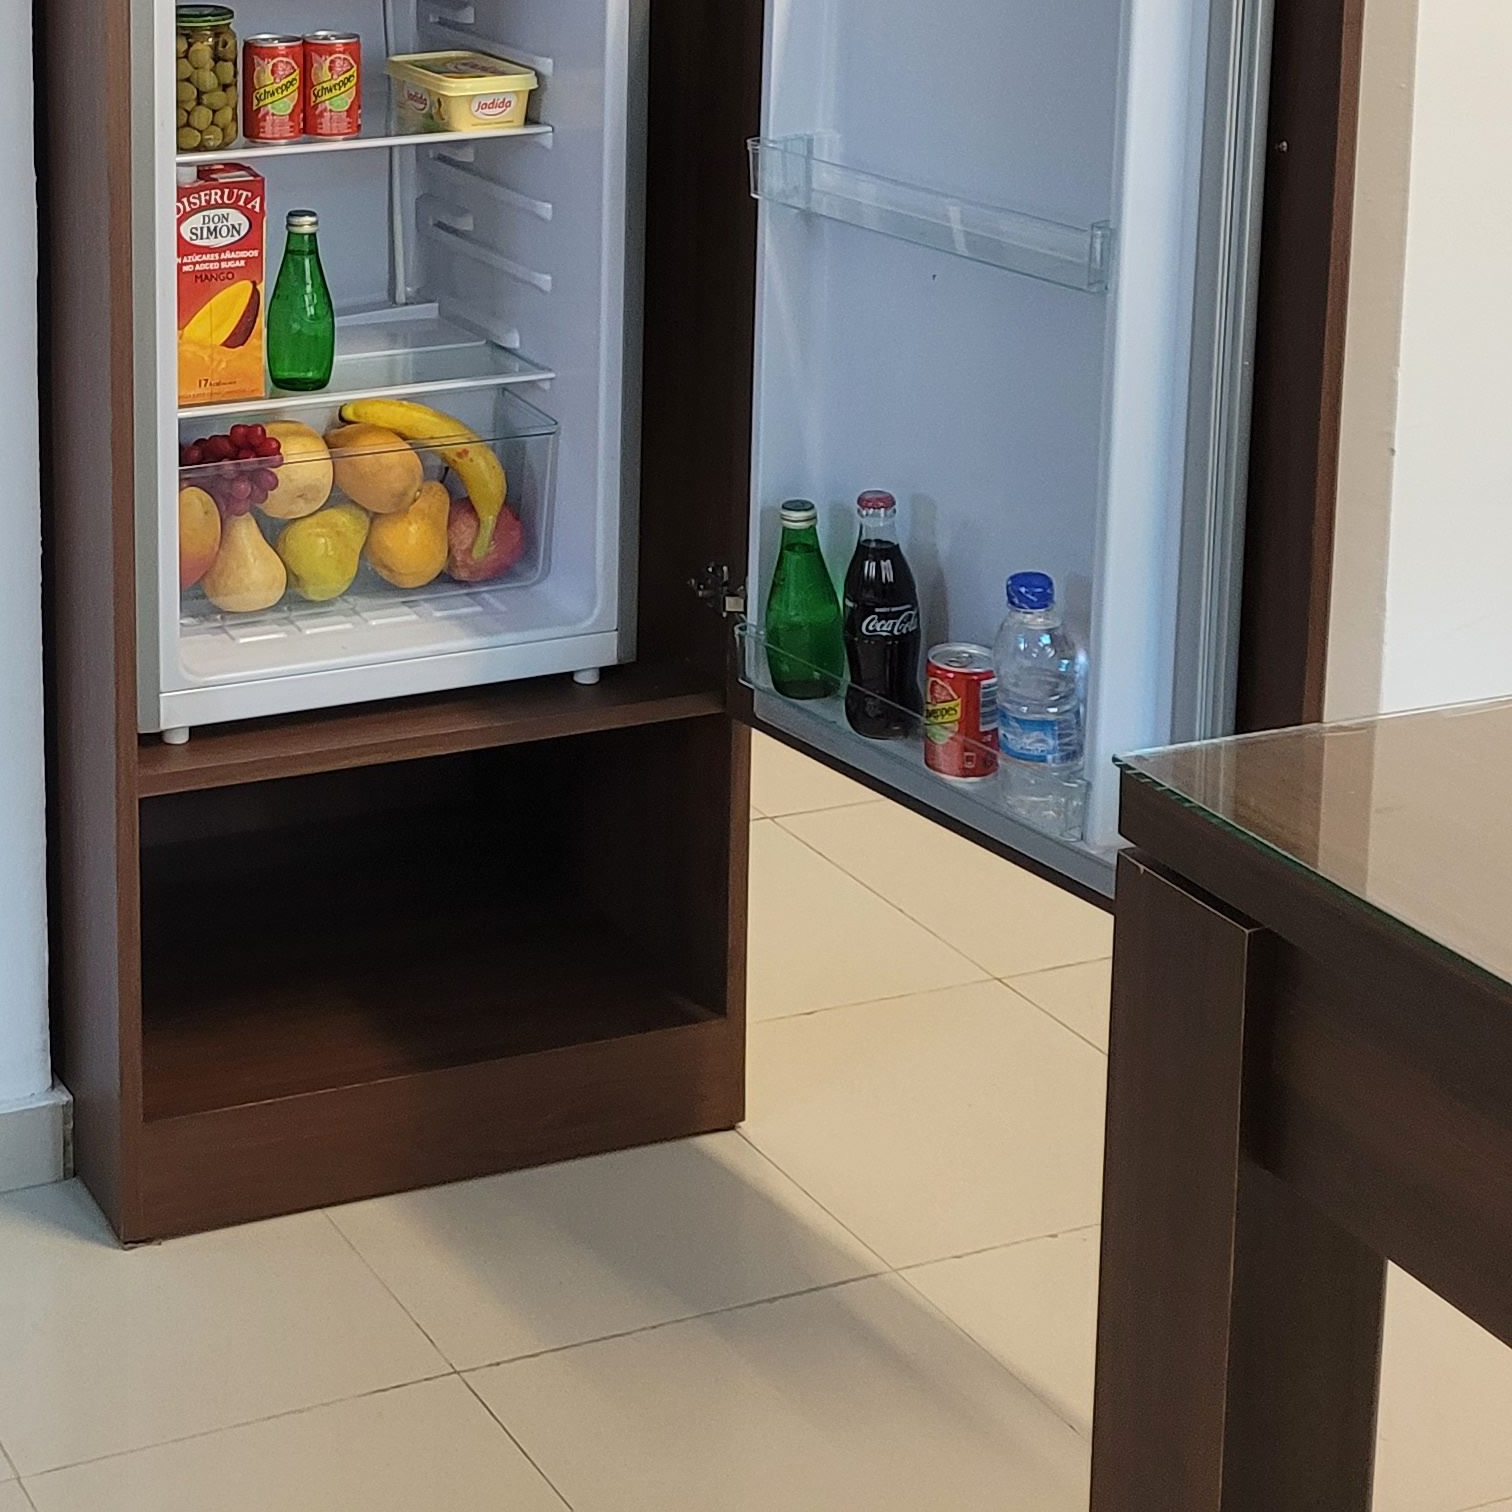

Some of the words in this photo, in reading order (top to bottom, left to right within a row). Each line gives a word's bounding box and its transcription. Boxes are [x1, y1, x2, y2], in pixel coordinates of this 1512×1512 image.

[254, 77, 298, 107] Schweppes
[312, 73, 355, 104] Schweppes
[475, 97, 512, 113] Jadida
[202, 213, 230, 226] DON
[189, 223, 242, 242] SIMON
[182, 264, 194, 272] NO
[195, 261, 219, 270] ADDED
[220, 259, 246, 269] SUGAR
[194, 271, 235, 283] MANGO
